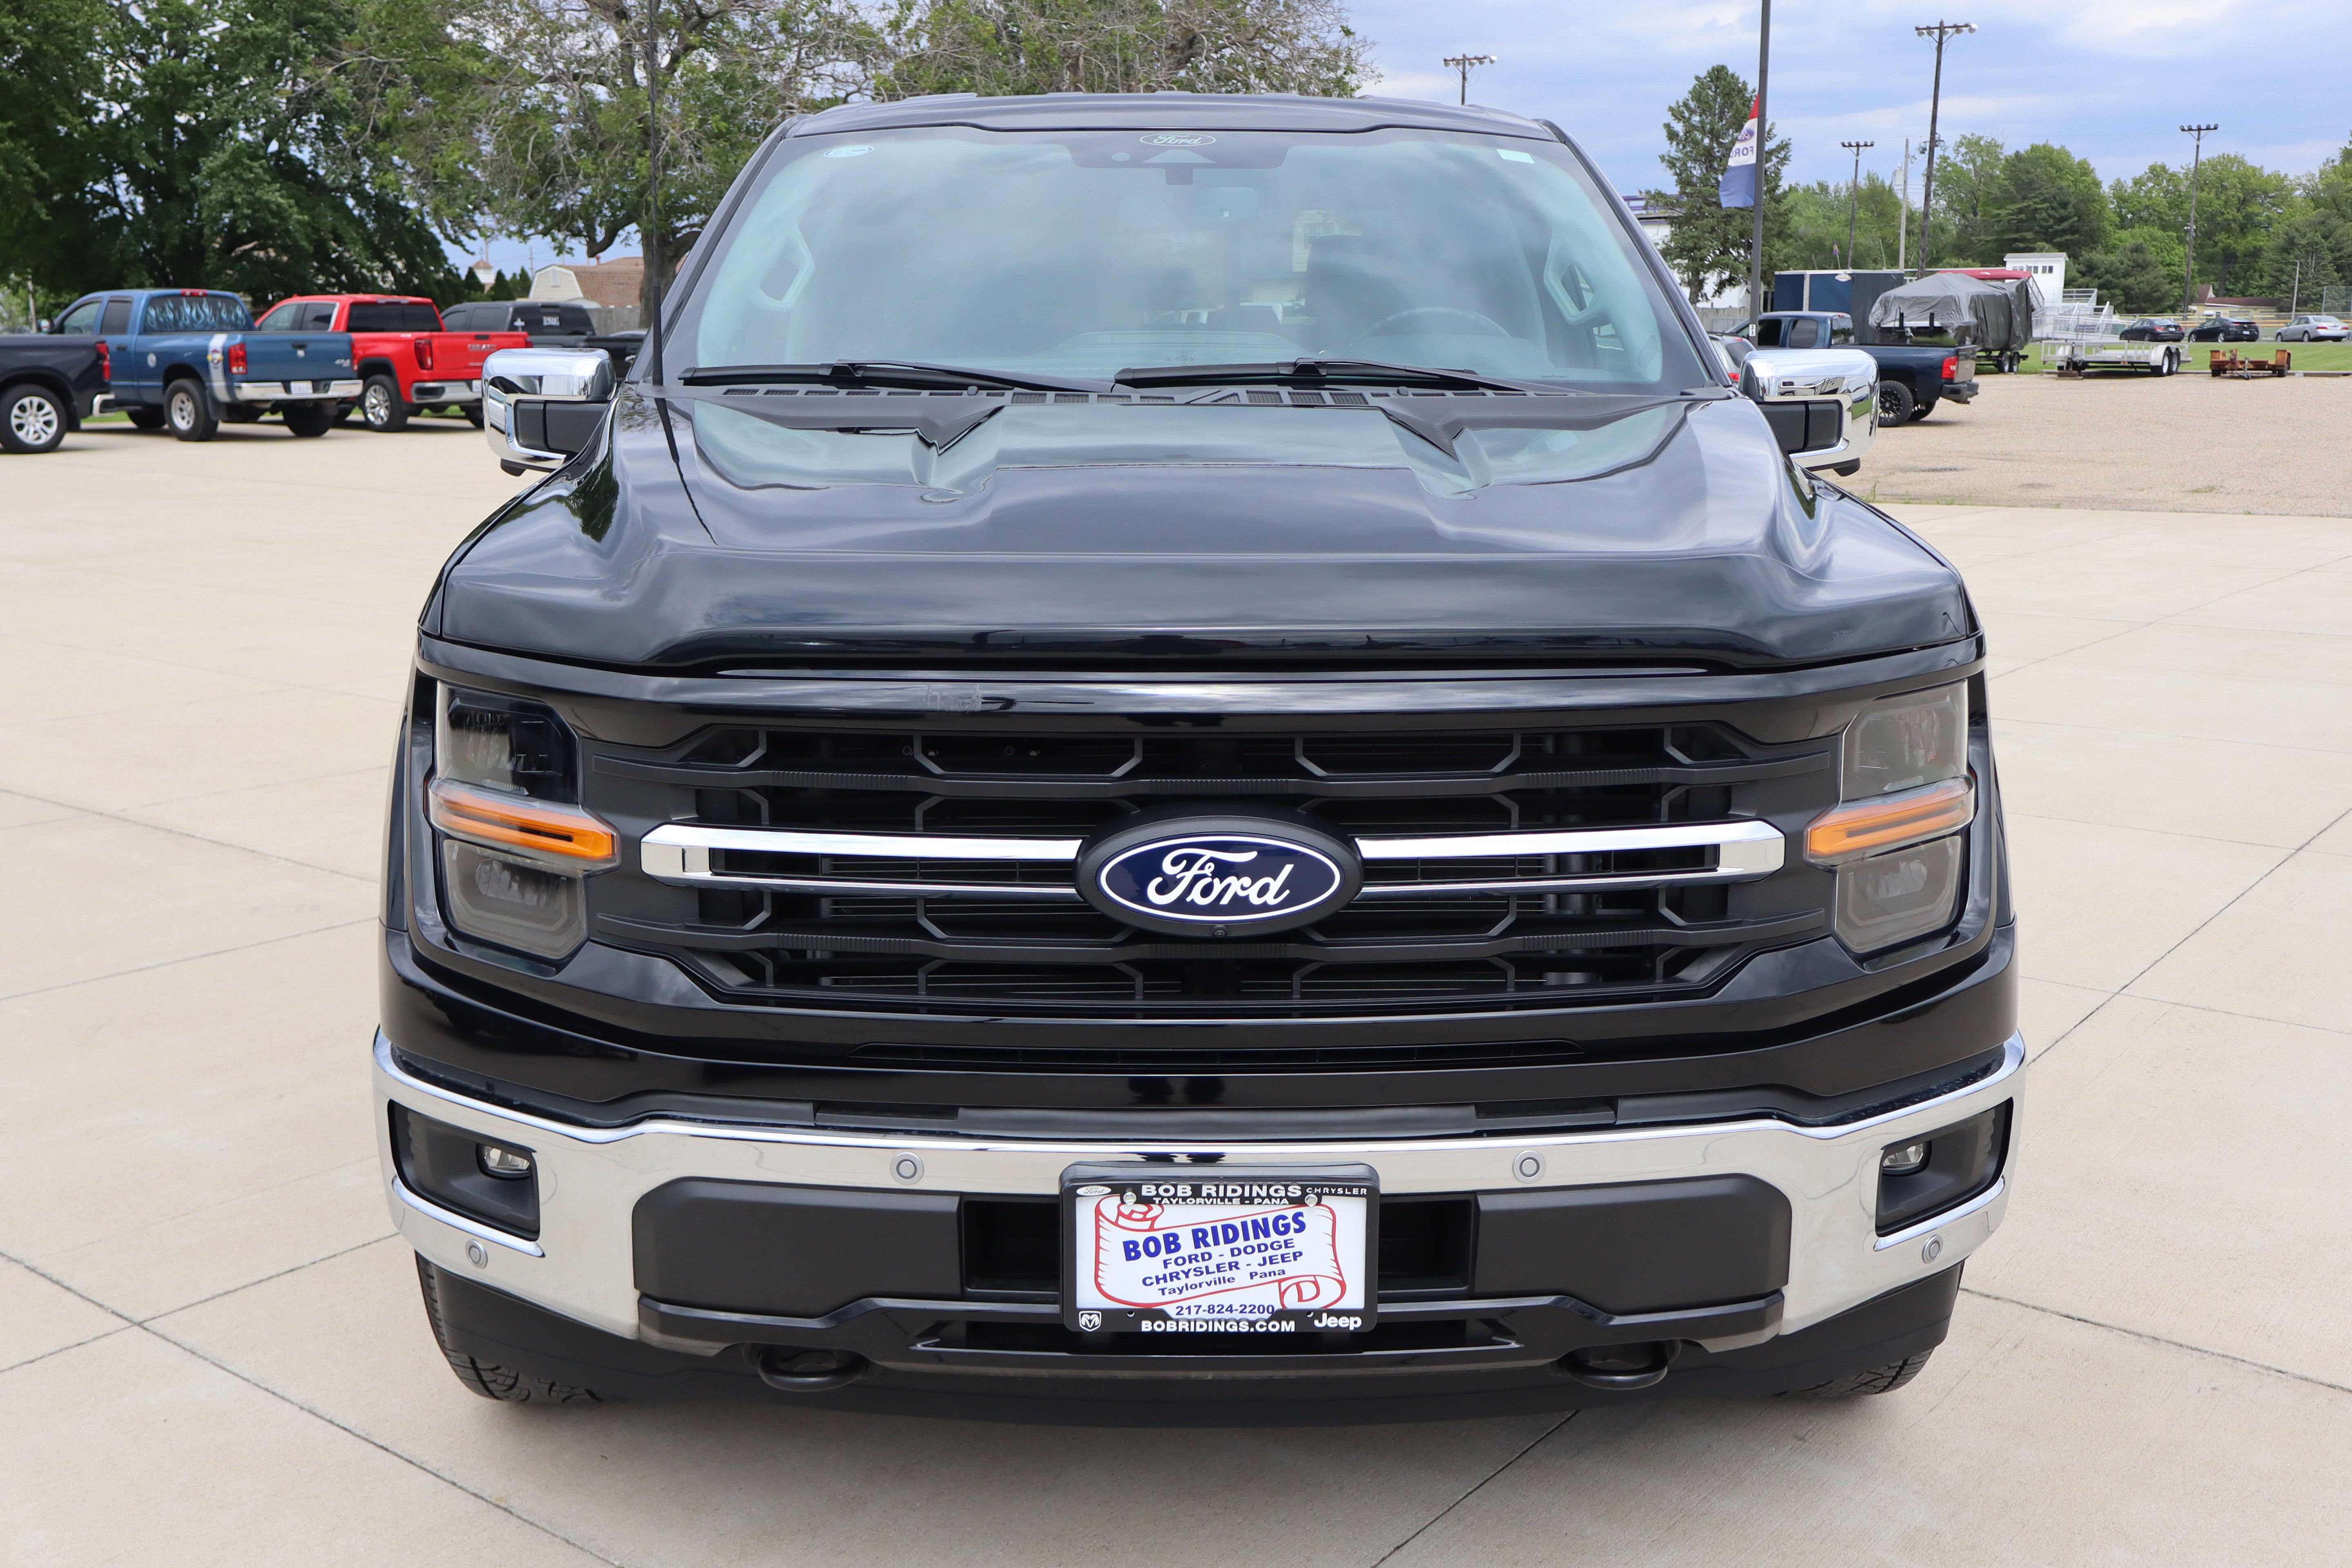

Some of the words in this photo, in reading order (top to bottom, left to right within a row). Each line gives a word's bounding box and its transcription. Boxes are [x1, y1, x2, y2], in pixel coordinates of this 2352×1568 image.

[1153, 135, 1203, 144] Ford
[1147, 848, 1294, 905] Ford
[1141, 1185, 1192, 1197] BOB
[1202, 1185, 1302, 1197] RIDINGS
[1122, 1232, 1182, 1262] BOB
[1191, 1211, 1307, 1250] RIDINGS
[1163, 1251, 1213, 1269] FORD
[1230, 1238, 1295, 1258] DODGE
[1142, 1261, 1241, 1287] CHRYSLER
[1257, 1251, 1303, 1267] JEEP
[1158, 1276, 1236, 1296] Taylorville
[1249, 1268, 1286, 1280] Pana
[1175, 1304, 1275, 1316] 217-824-2200
[1314, 1312, 1363, 1330] Jeep
[1141, 1320, 1295, 1332] BOBRIDINGS.COM
